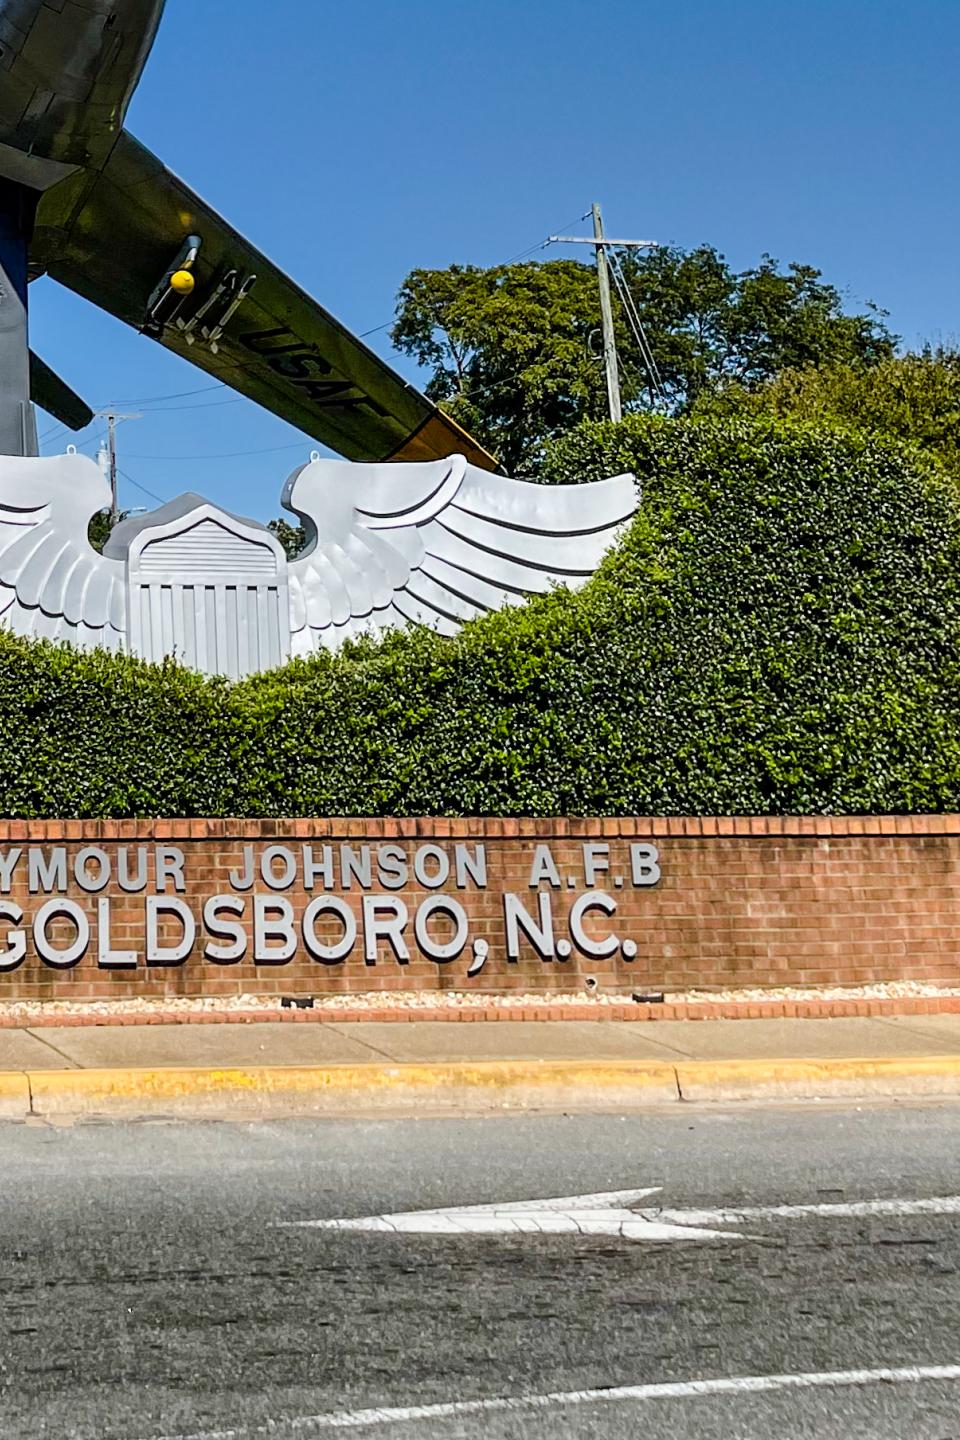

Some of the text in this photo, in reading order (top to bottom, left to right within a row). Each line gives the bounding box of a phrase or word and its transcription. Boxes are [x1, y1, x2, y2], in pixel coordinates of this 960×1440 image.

[239, 326, 391, 417] USAF
[231, 842, 488, 890] JOHNSON
[529, 842, 662, 888] A.F.B
[503, 892, 639, 959] N.C.
